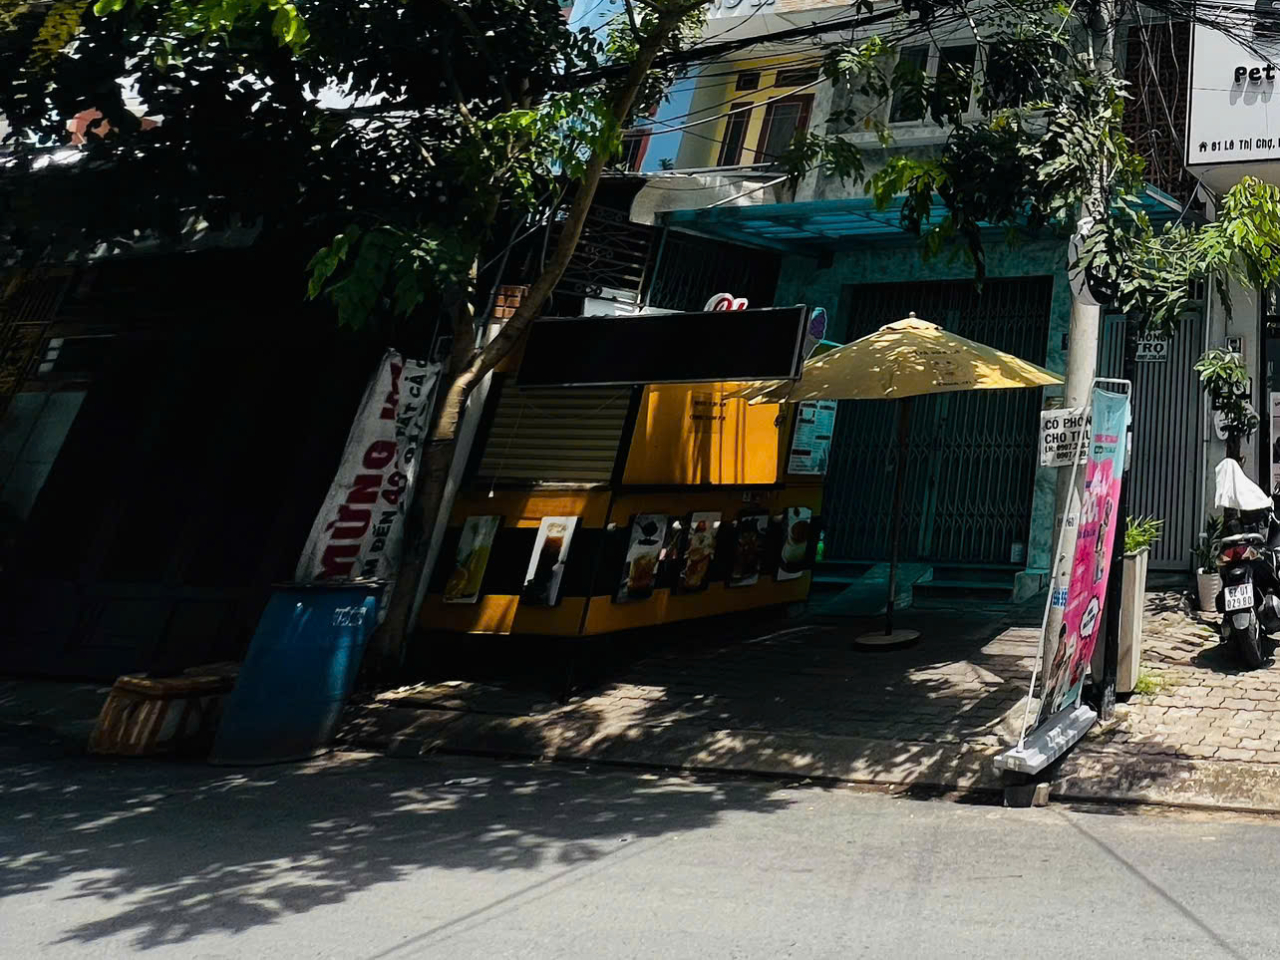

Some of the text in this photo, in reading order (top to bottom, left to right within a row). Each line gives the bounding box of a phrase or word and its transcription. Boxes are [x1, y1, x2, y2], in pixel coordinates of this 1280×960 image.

[1234, 63, 1276, 85] Pet
[1045, 416, 1059, 431] CÓ
[1045, 432, 1067, 445] CHO
